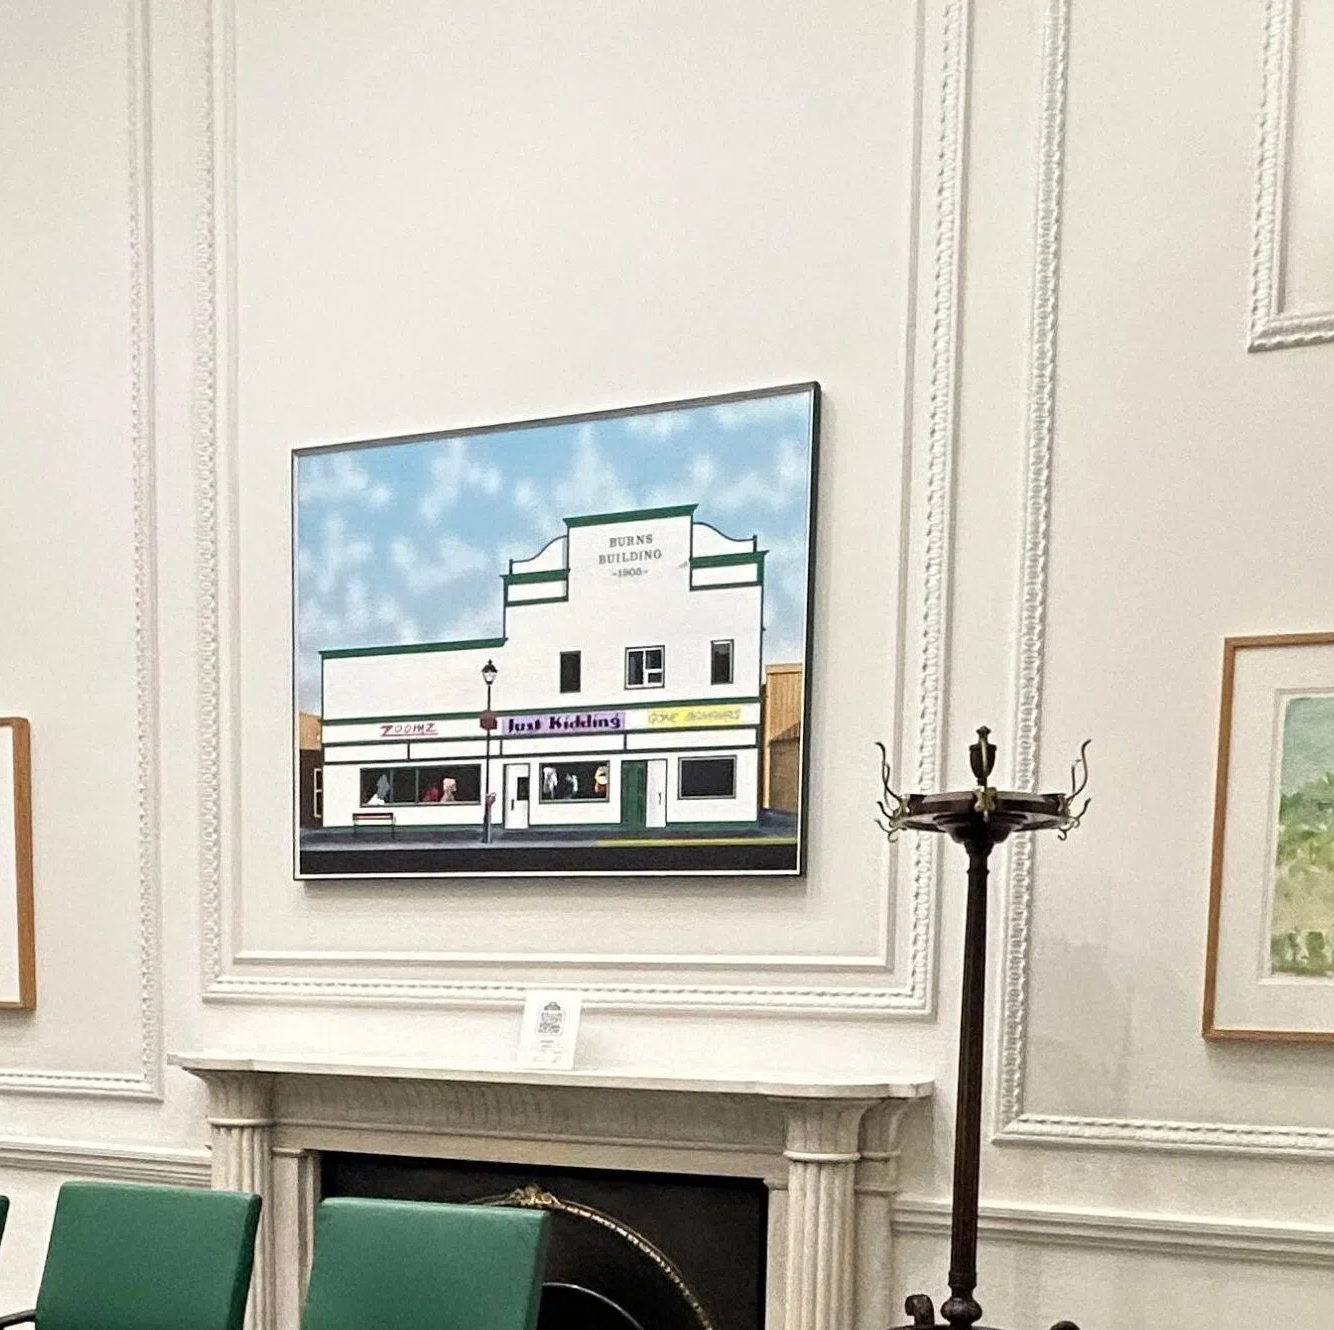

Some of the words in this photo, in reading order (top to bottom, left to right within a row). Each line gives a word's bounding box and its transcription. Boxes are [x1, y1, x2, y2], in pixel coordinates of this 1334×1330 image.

[609, 534, 653, 548] BURNS
[508, 718, 542, 733] Just
[549, 713, 621, 730] Kidding
